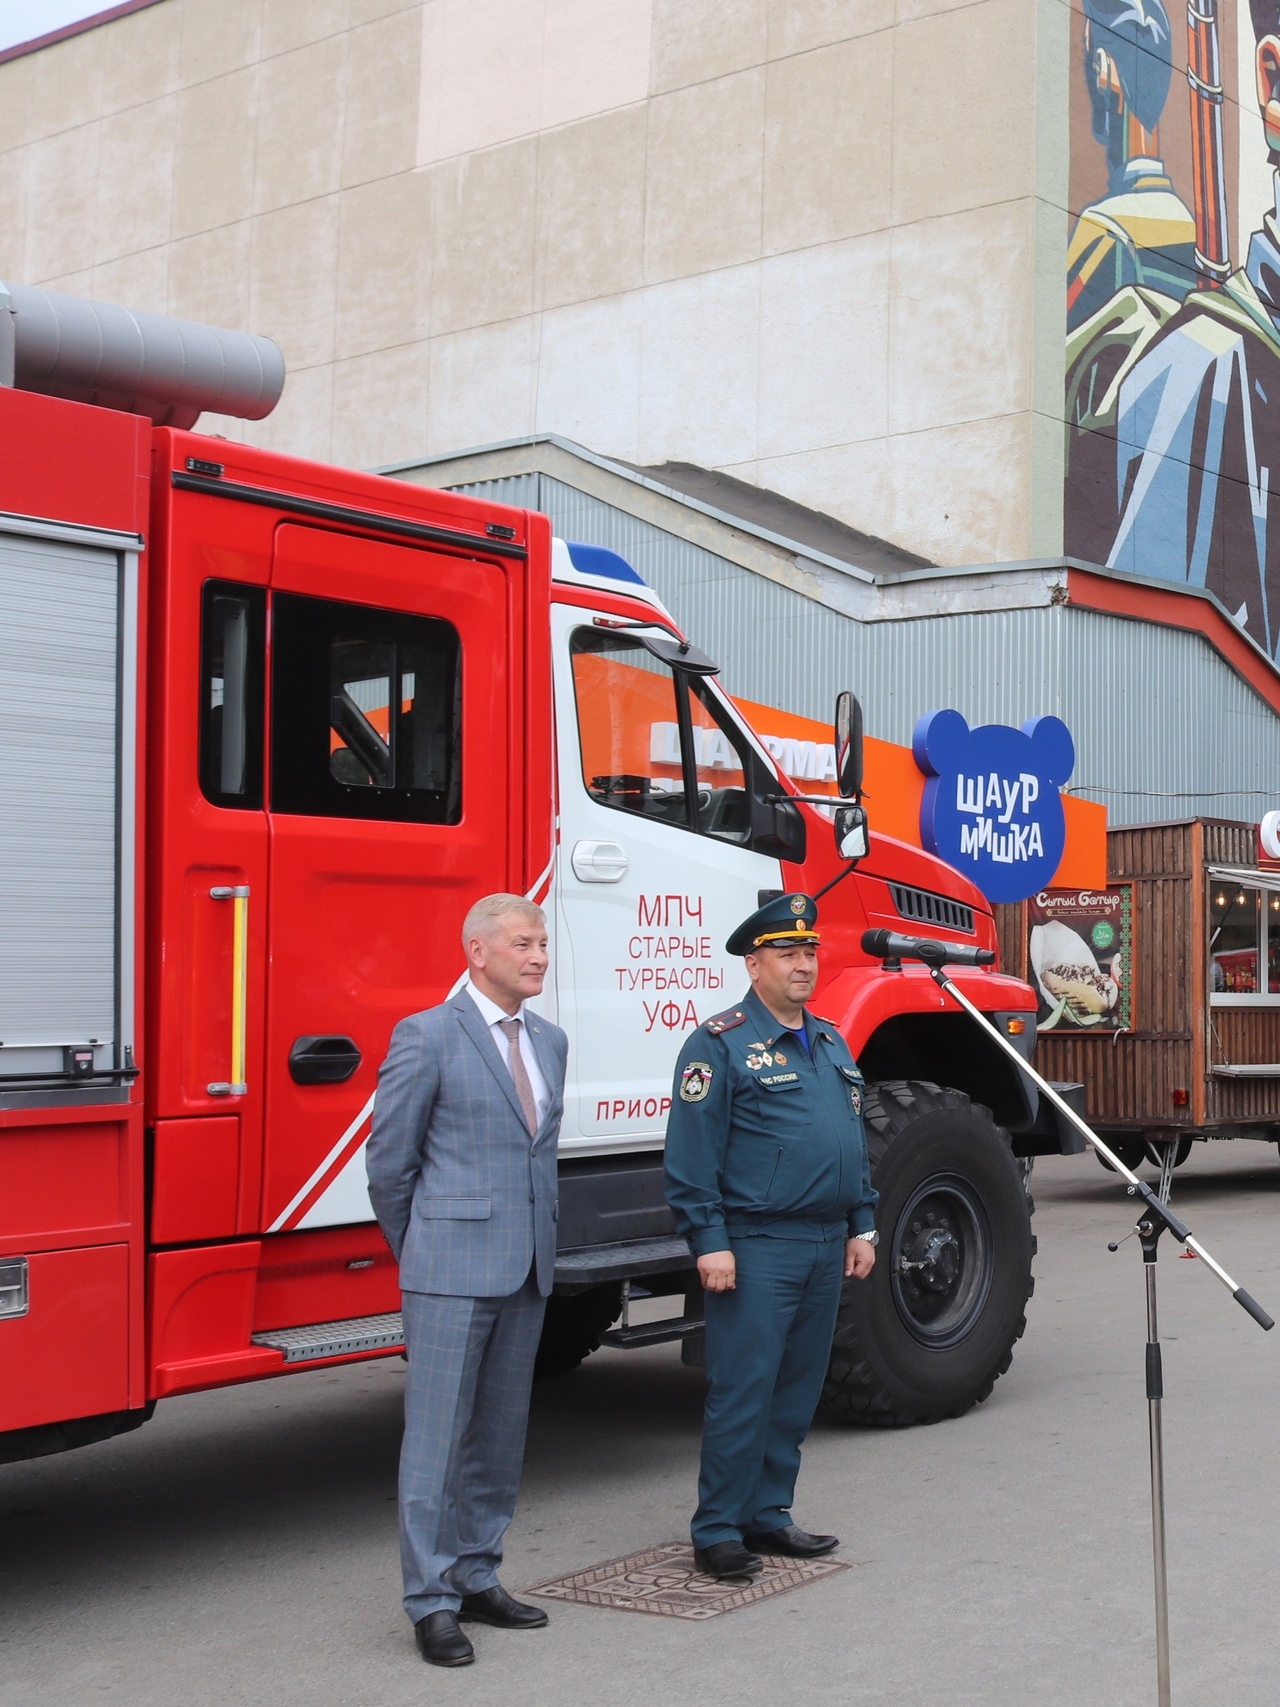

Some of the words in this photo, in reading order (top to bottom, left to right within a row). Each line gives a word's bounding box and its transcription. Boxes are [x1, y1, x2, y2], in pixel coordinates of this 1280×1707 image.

[650, 722, 837, 783] ШАРМА
[957, 773, 1039, 824] ШАУР
[960, 816, 1044, 864] МИШКА
[638, 895, 703, 927] МПЧ
[1036, 892, 1077, 907] Сытый
[1078, 891, 1120, 911] Батыр
[628, 937, 712, 959] СТАРЫЕ
[615, 967, 724, 991] ТУРБАСЛЫ
[642, 999, 699, 1033] УФА
[773, 1073, 798, 1083] РОССИИ
